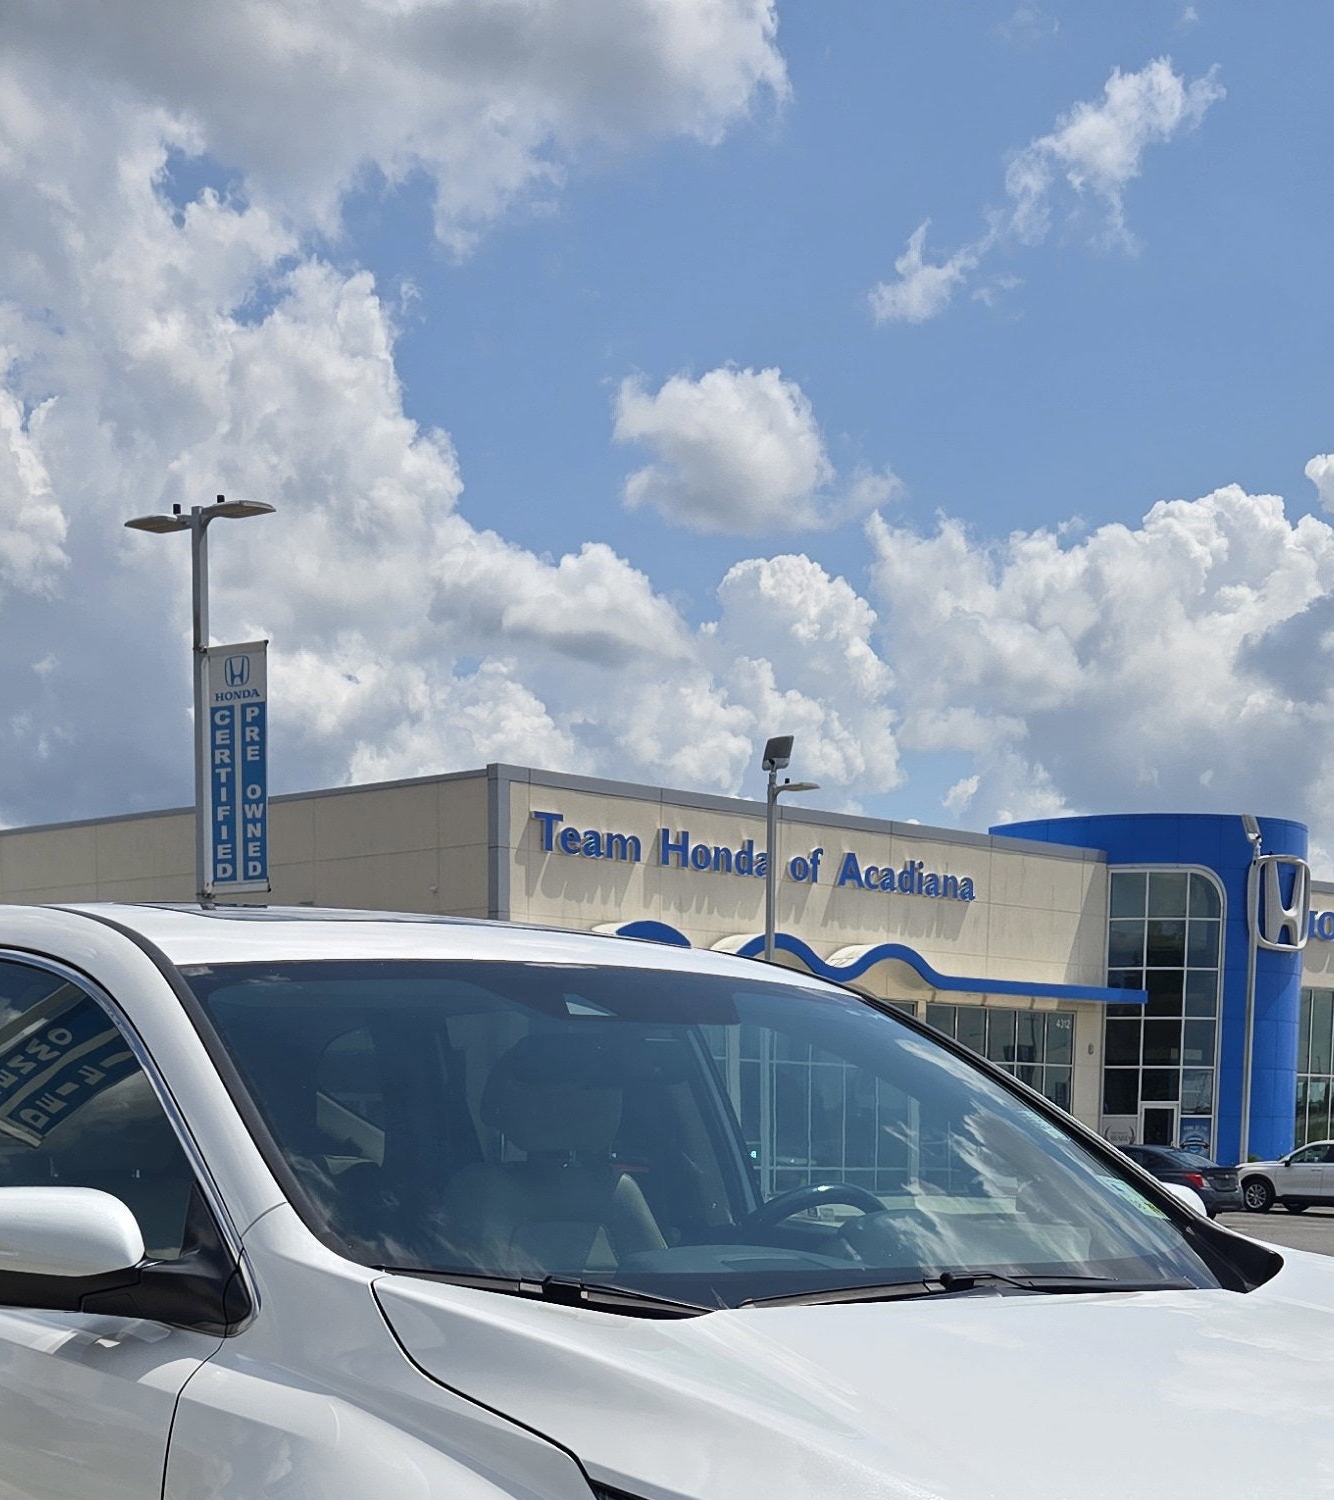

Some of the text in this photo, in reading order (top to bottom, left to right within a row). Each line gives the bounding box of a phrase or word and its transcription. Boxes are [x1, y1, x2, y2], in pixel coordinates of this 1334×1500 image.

[215, 689, 261, 702] HONDA
[214, 710, 233, 878] CERTIFIED
[244, 707, 264, 877] PRE OWNED
[532, 810, 976, 902] Team Honda of Acadiana
